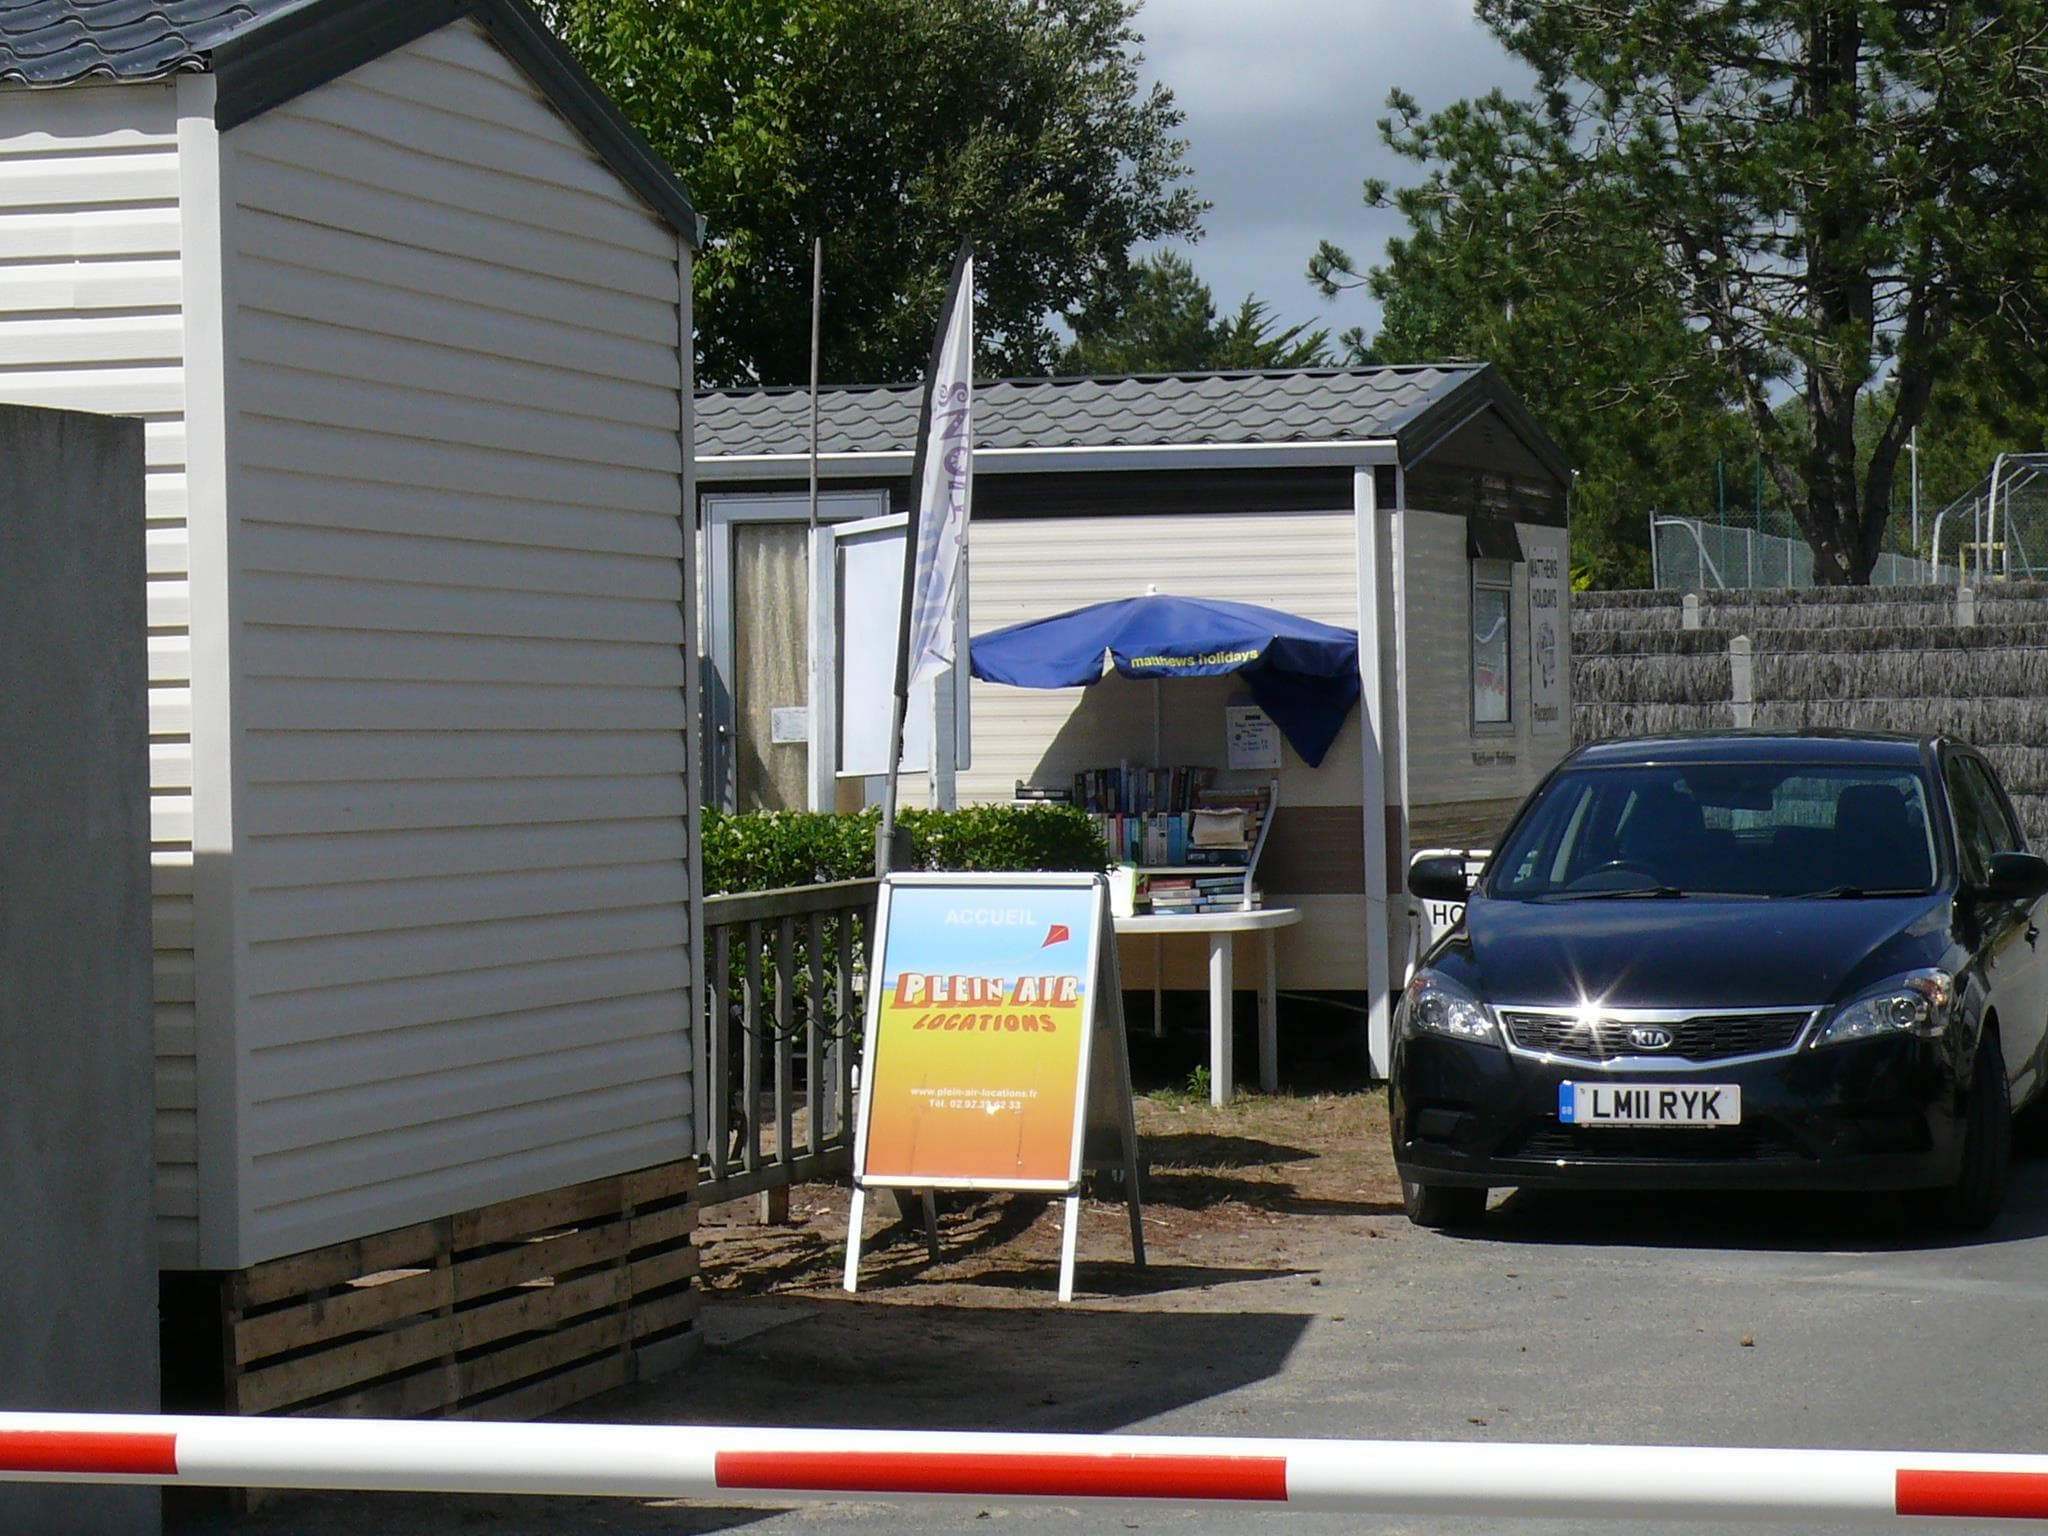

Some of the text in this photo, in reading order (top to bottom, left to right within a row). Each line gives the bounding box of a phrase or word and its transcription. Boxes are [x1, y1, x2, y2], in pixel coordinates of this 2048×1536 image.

[1130, 649, 1260, 669] matthews holidays
[944, 908, 1037, 926] ACCUEIL
[891, 972, 1080, 1009] PLEIN AIR
[912, 1013, 1057, 1033] LOCATIONS
[1636, 1031, 1667, 1046] KIA
[1658, 1090, 1721, 1120] RYK
